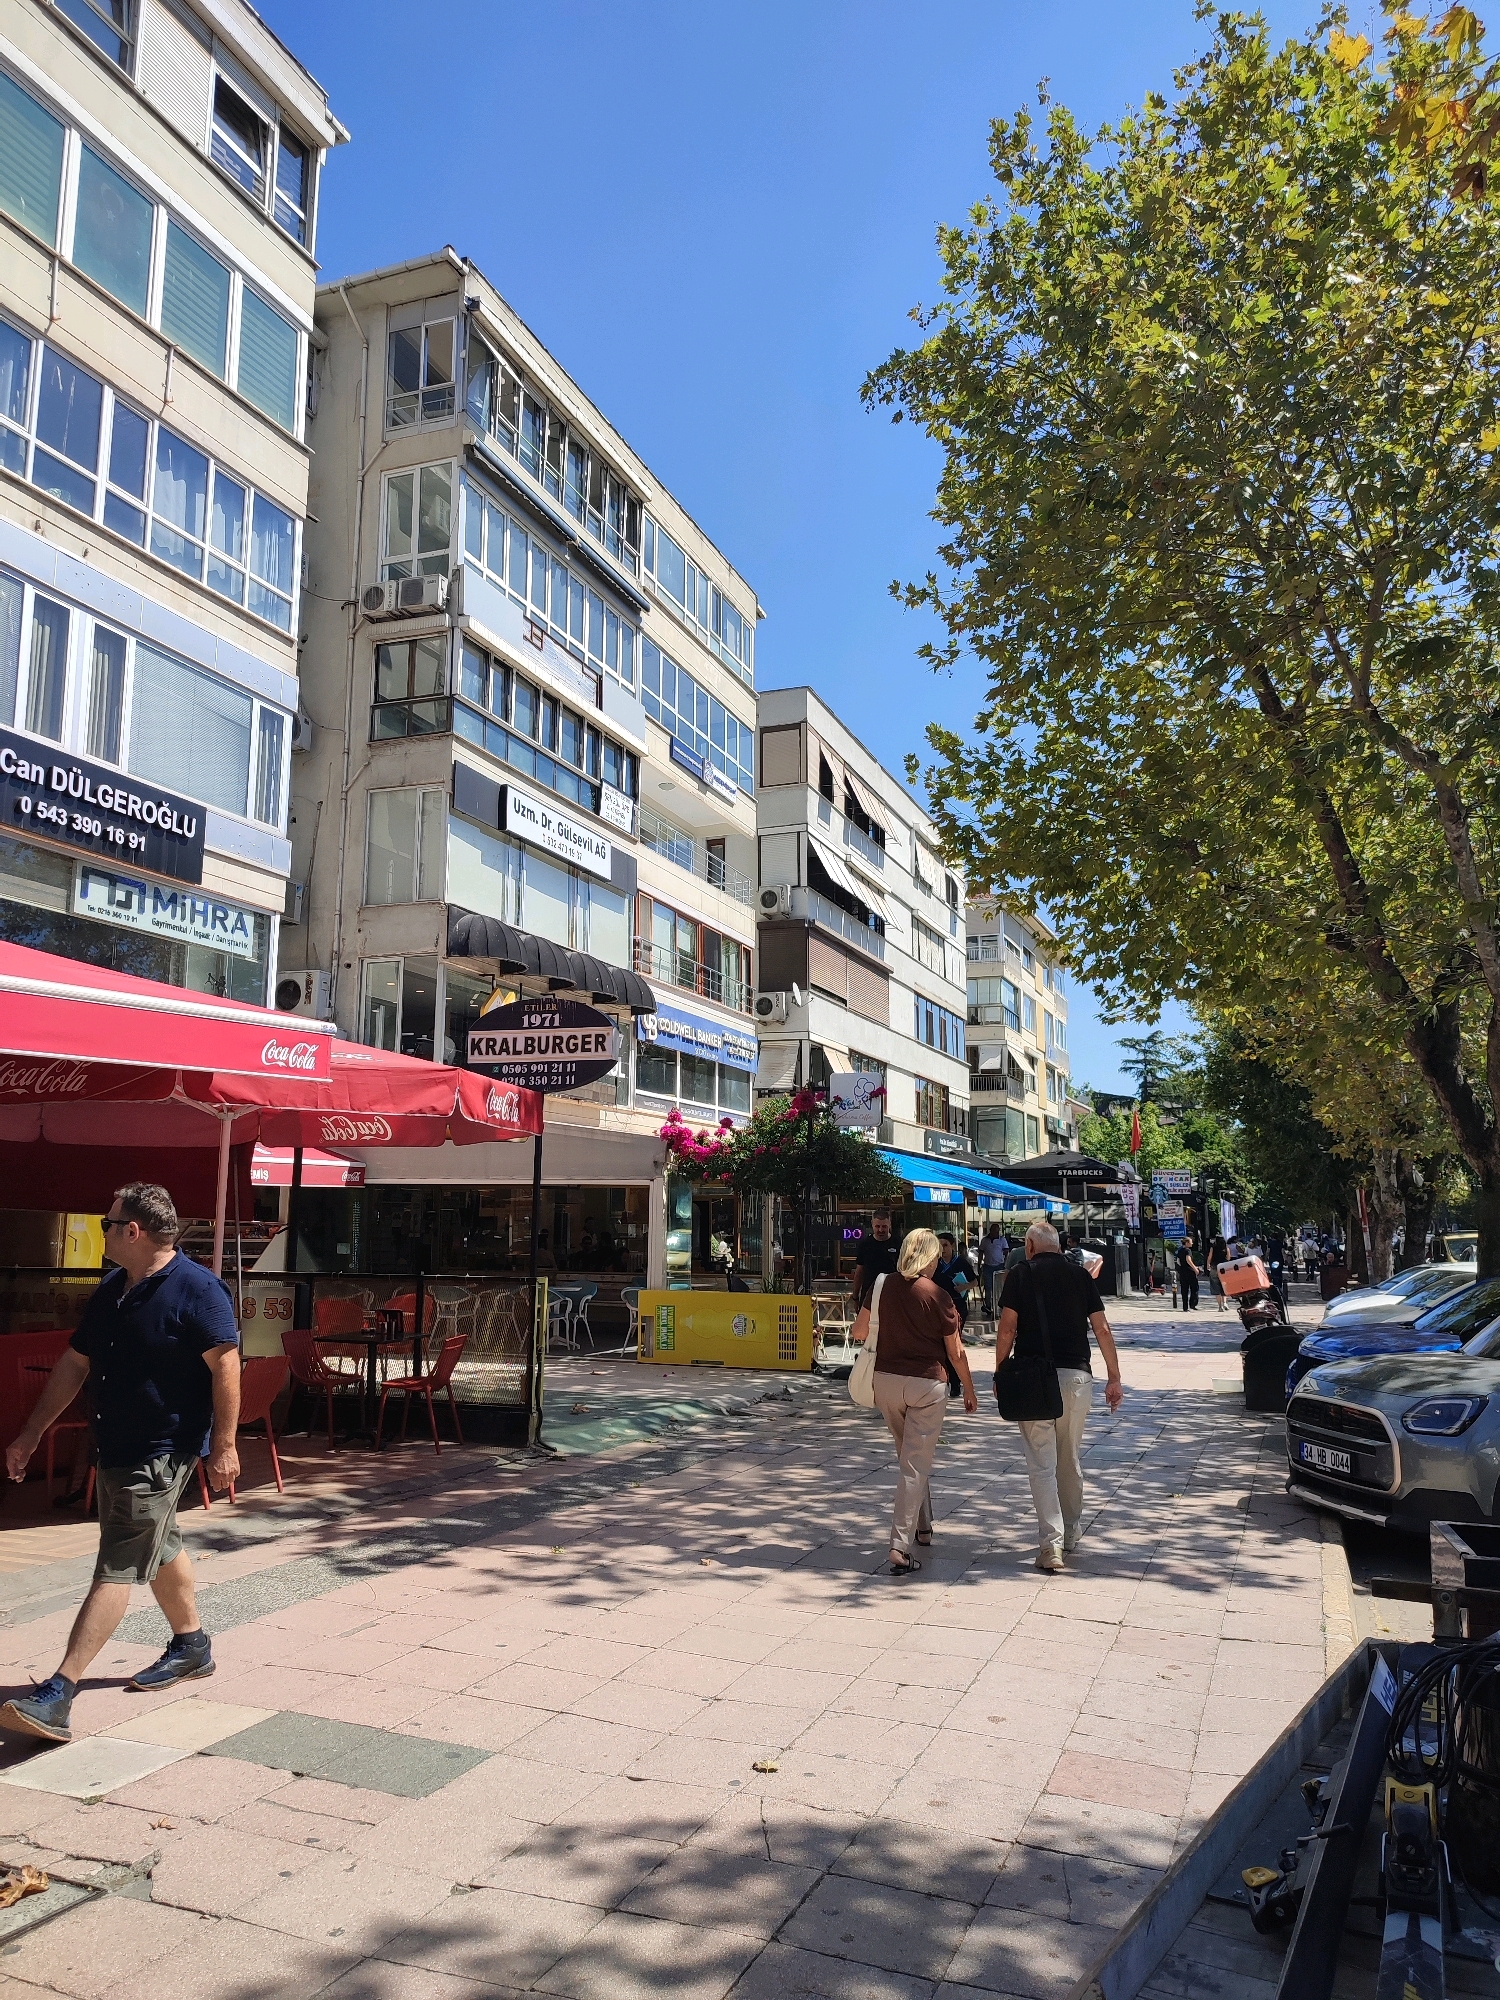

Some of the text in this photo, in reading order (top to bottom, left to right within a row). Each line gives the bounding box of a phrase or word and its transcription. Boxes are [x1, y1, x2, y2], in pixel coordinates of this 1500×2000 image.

[0, 748, 197, 838] Can DÜLGEROĞLU
[21, 796, 146, 852] 0 543 390 16 91
[513, 796, 539, 825] Uzm.
[541, 811, 555, 833] Dr.
[557, 821, 593, 854] Gülsevil
[522, 1013, 561, 1028] 1971
[658, 1017, 697, 1041] COLDWELL
[697, 1029, 722, 1049] BANKER
[470, 1033, 607, 1056] KRALBURGER
[502, 1062, 576, 1074] 0505 991 21 11
[528, 1075, 548, 1085] 350
[550, 1075, 562, 1085] 21
[565, 1074, 575, 1085] 11
[263, 1297, 293, 1321] 53
[1304, 1444, 1313, 1460] 34
[1330, 1451, 1350, 1471] 0044
